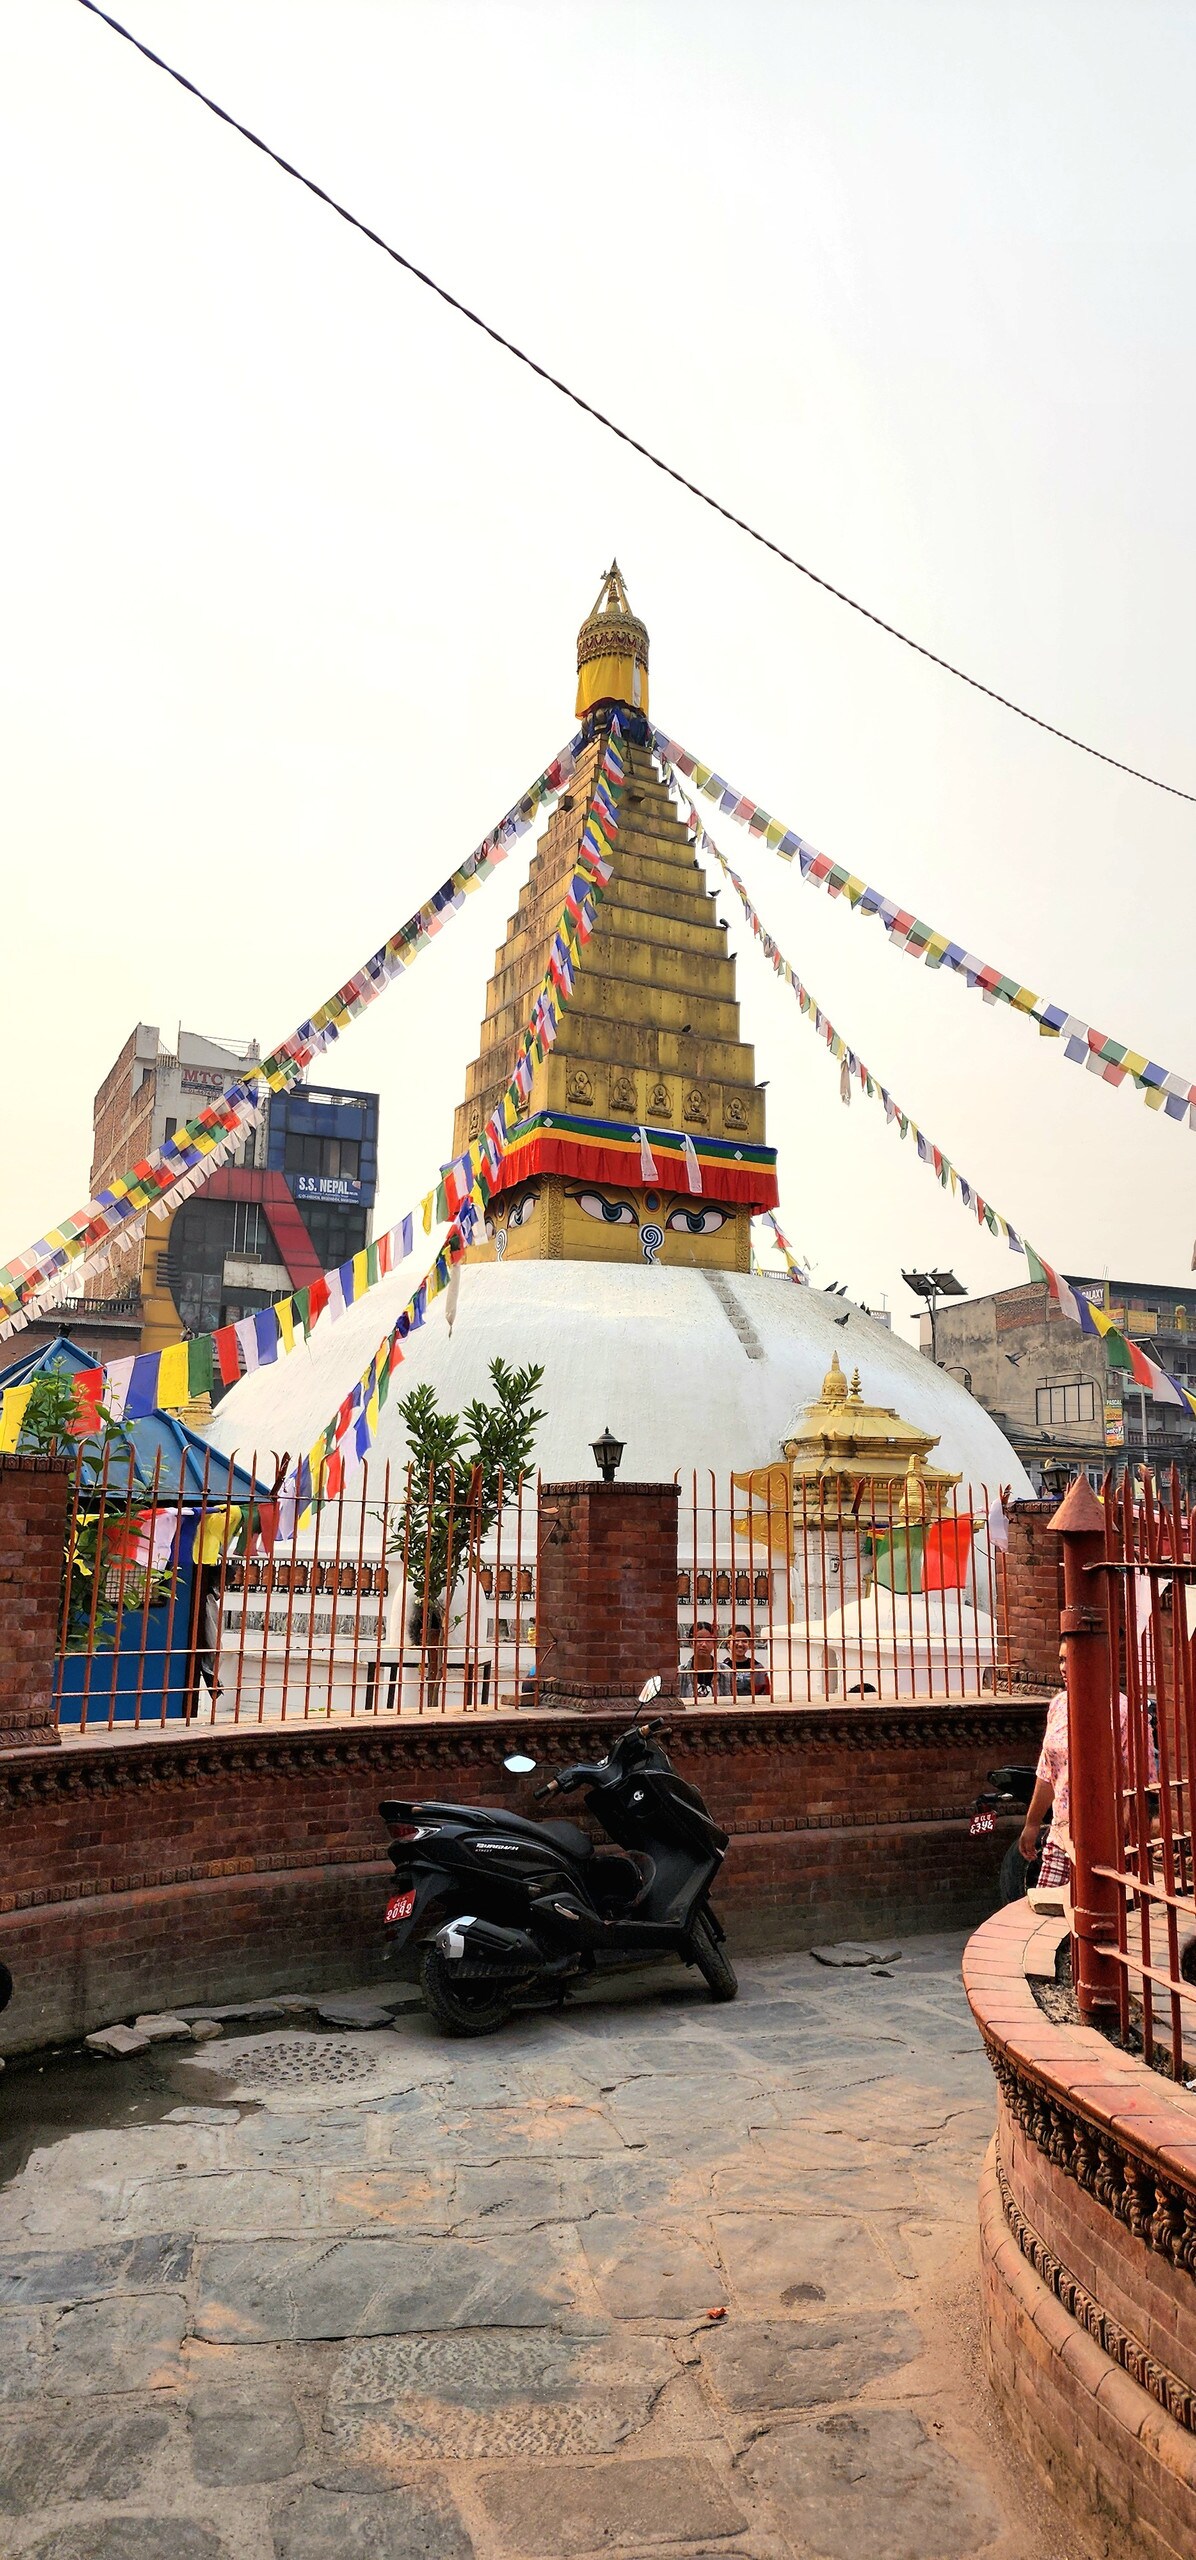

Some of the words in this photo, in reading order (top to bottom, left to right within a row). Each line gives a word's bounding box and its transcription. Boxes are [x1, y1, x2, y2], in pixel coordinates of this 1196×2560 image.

[183, 1069, 223, 1085] MTC
[299, 1176, 317, 1192] S.S.
[320, 1179, 349, 1195] NEPAL
